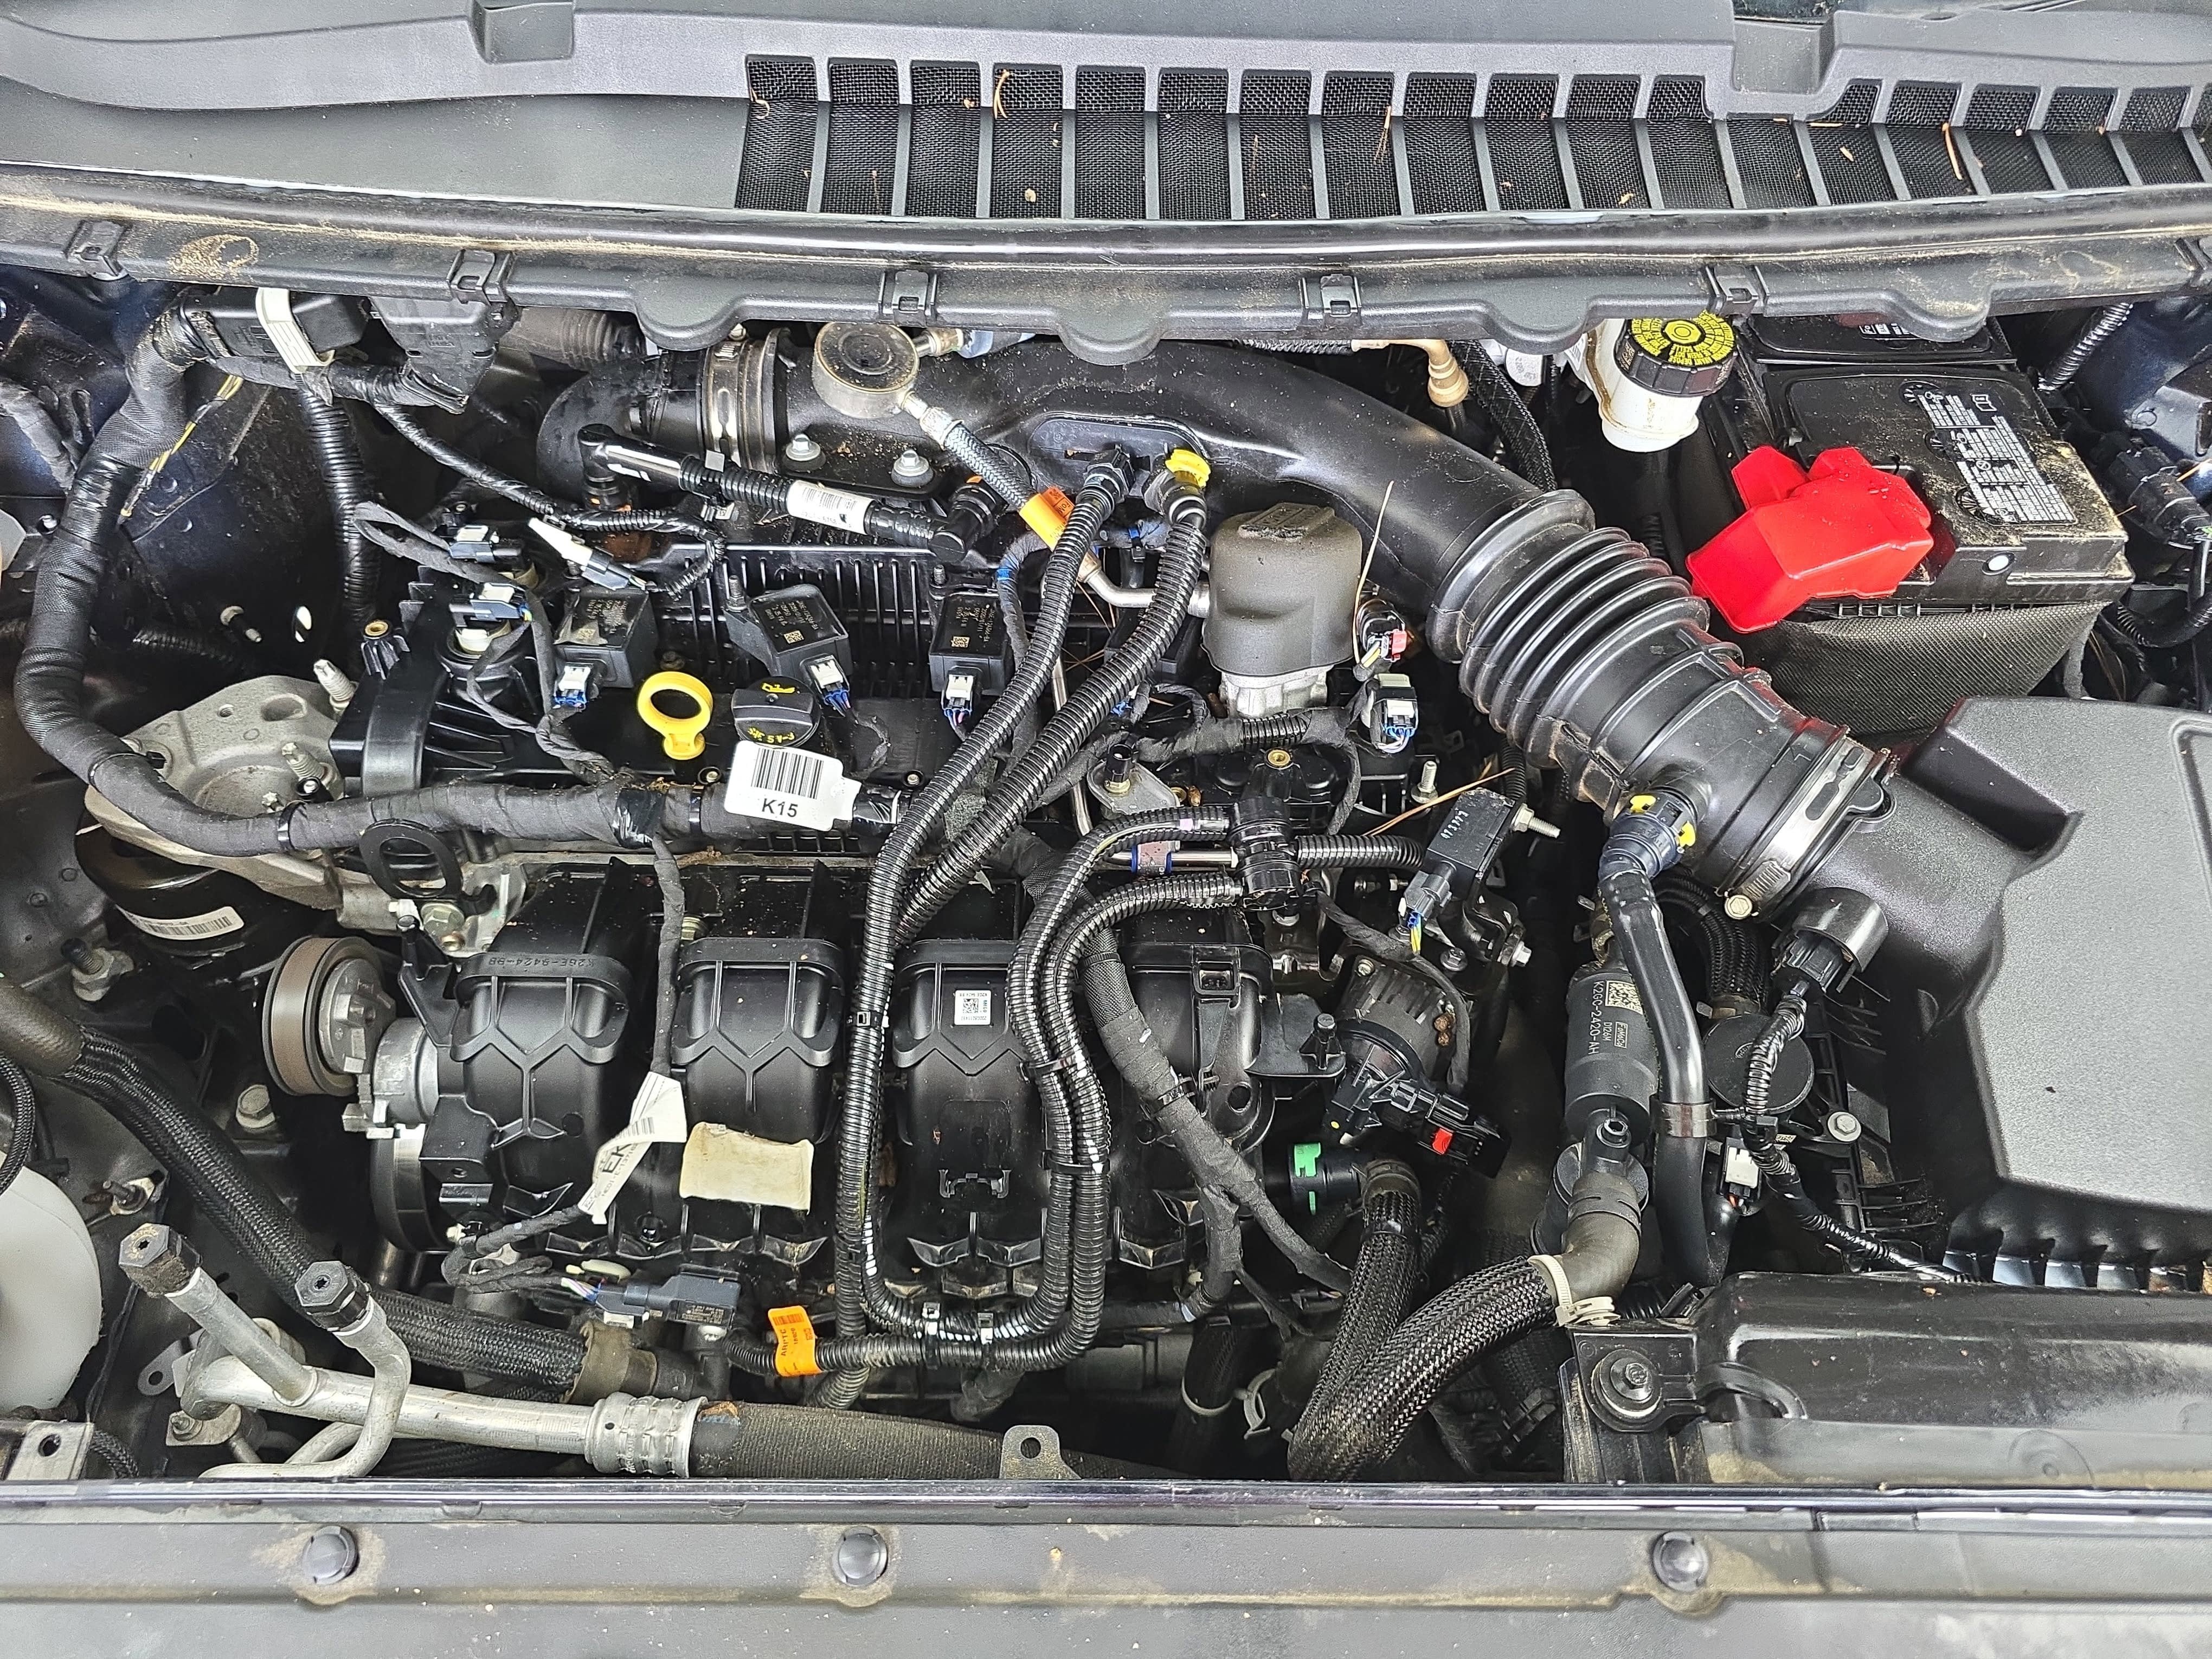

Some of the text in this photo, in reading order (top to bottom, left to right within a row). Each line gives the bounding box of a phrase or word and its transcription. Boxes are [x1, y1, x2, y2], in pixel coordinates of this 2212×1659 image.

[761, 797, 798, 819] K15
[1587, 980, 1604, 1055] K2GC-2420-AH
[1602, 1021, 1612, 1041] D126M
[1617, 1023, 1625, 1046] FoMoCo
[602, 1143, 632, 1173] EK
